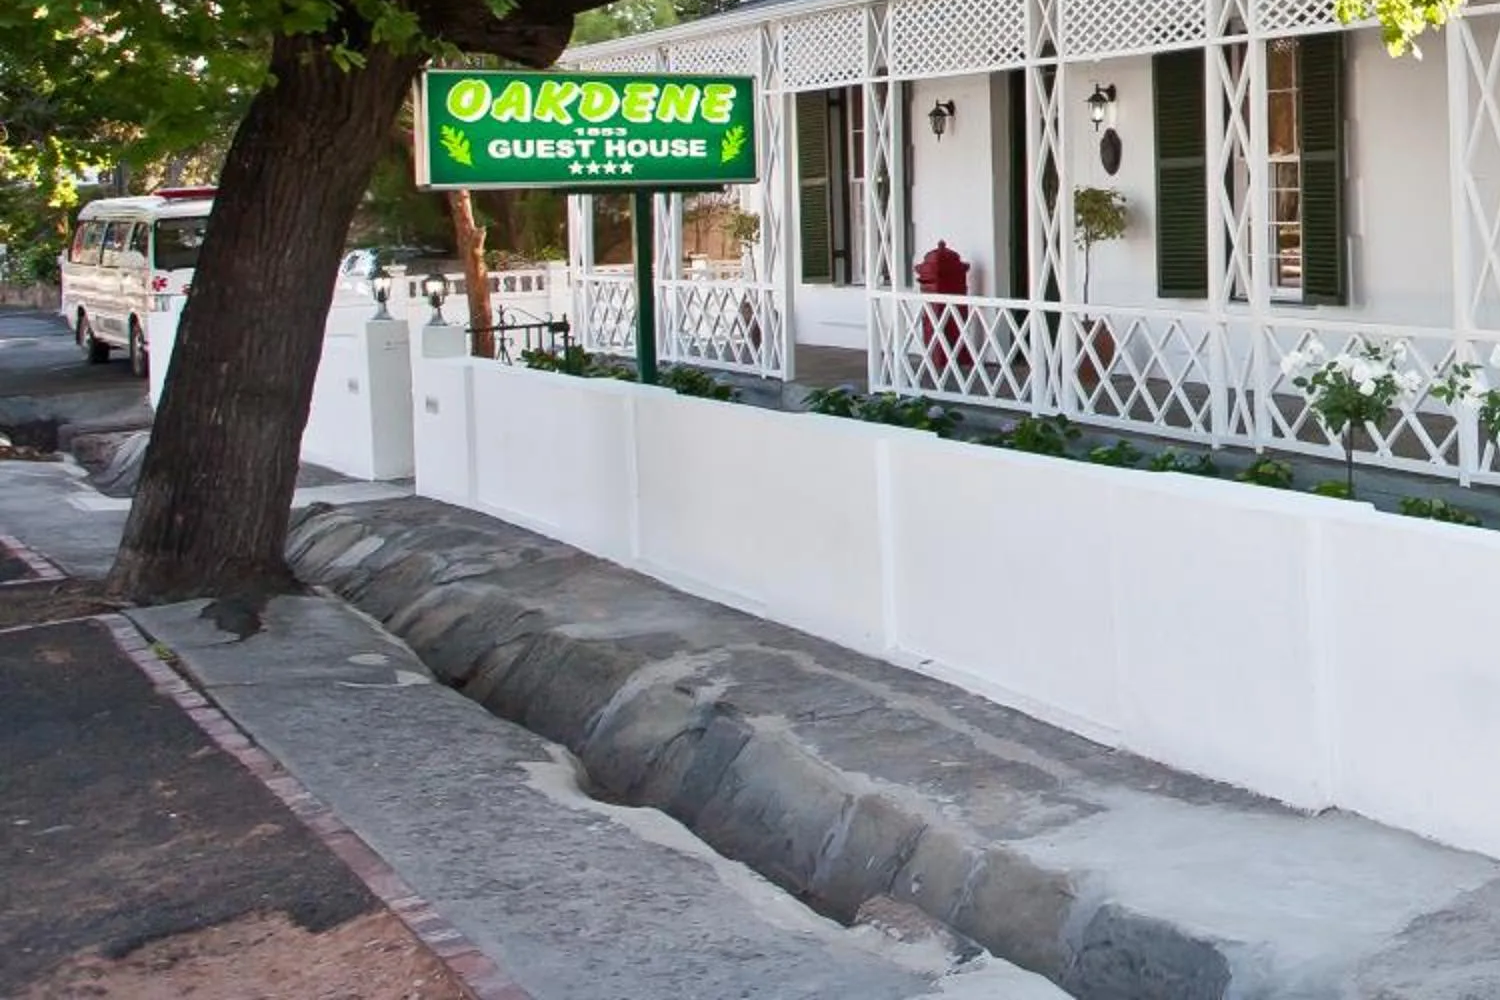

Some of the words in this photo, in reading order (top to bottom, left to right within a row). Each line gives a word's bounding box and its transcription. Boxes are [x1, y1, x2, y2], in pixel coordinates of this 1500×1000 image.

[447, 79, 737, 125] OAKDENE
[488, 139, 595, 159] GUEST
[605, 139, 707, 158] HOUSE
